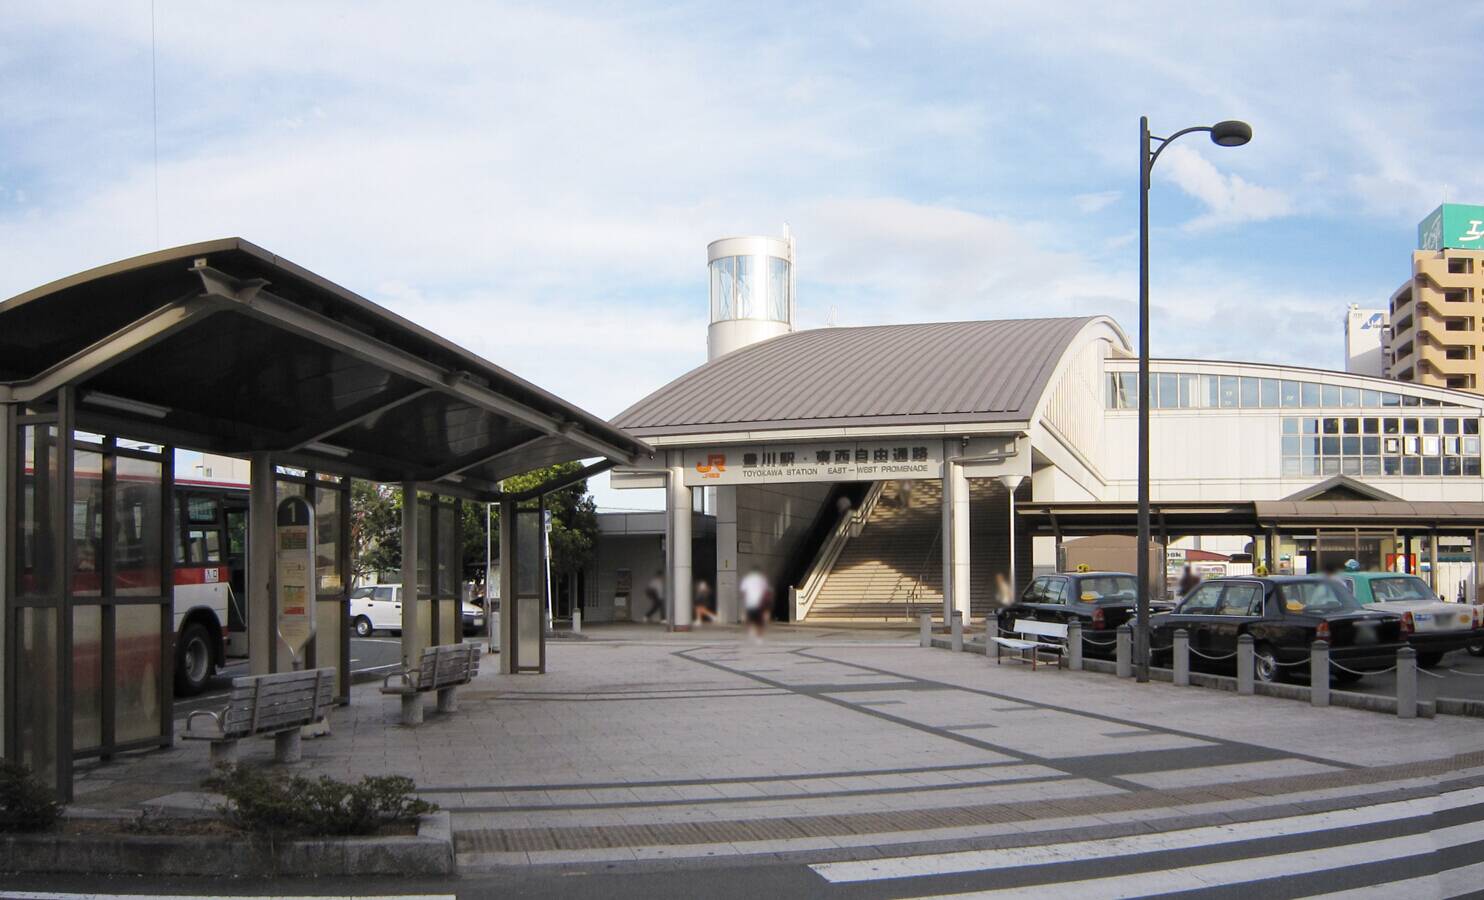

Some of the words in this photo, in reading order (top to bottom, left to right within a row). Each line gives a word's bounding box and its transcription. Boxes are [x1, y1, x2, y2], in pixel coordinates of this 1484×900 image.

[696, 454, 726, 473] JR
[743, 469, 783, 478] TOYOKAWA
[786, 468, 818, 476] STATION
[828, 467, 846, 475] EAST
[857, 465, 878, 474] WEST
[881, 464, 928, 473] PROMENADE
[287, 502, 296, 522] 1
